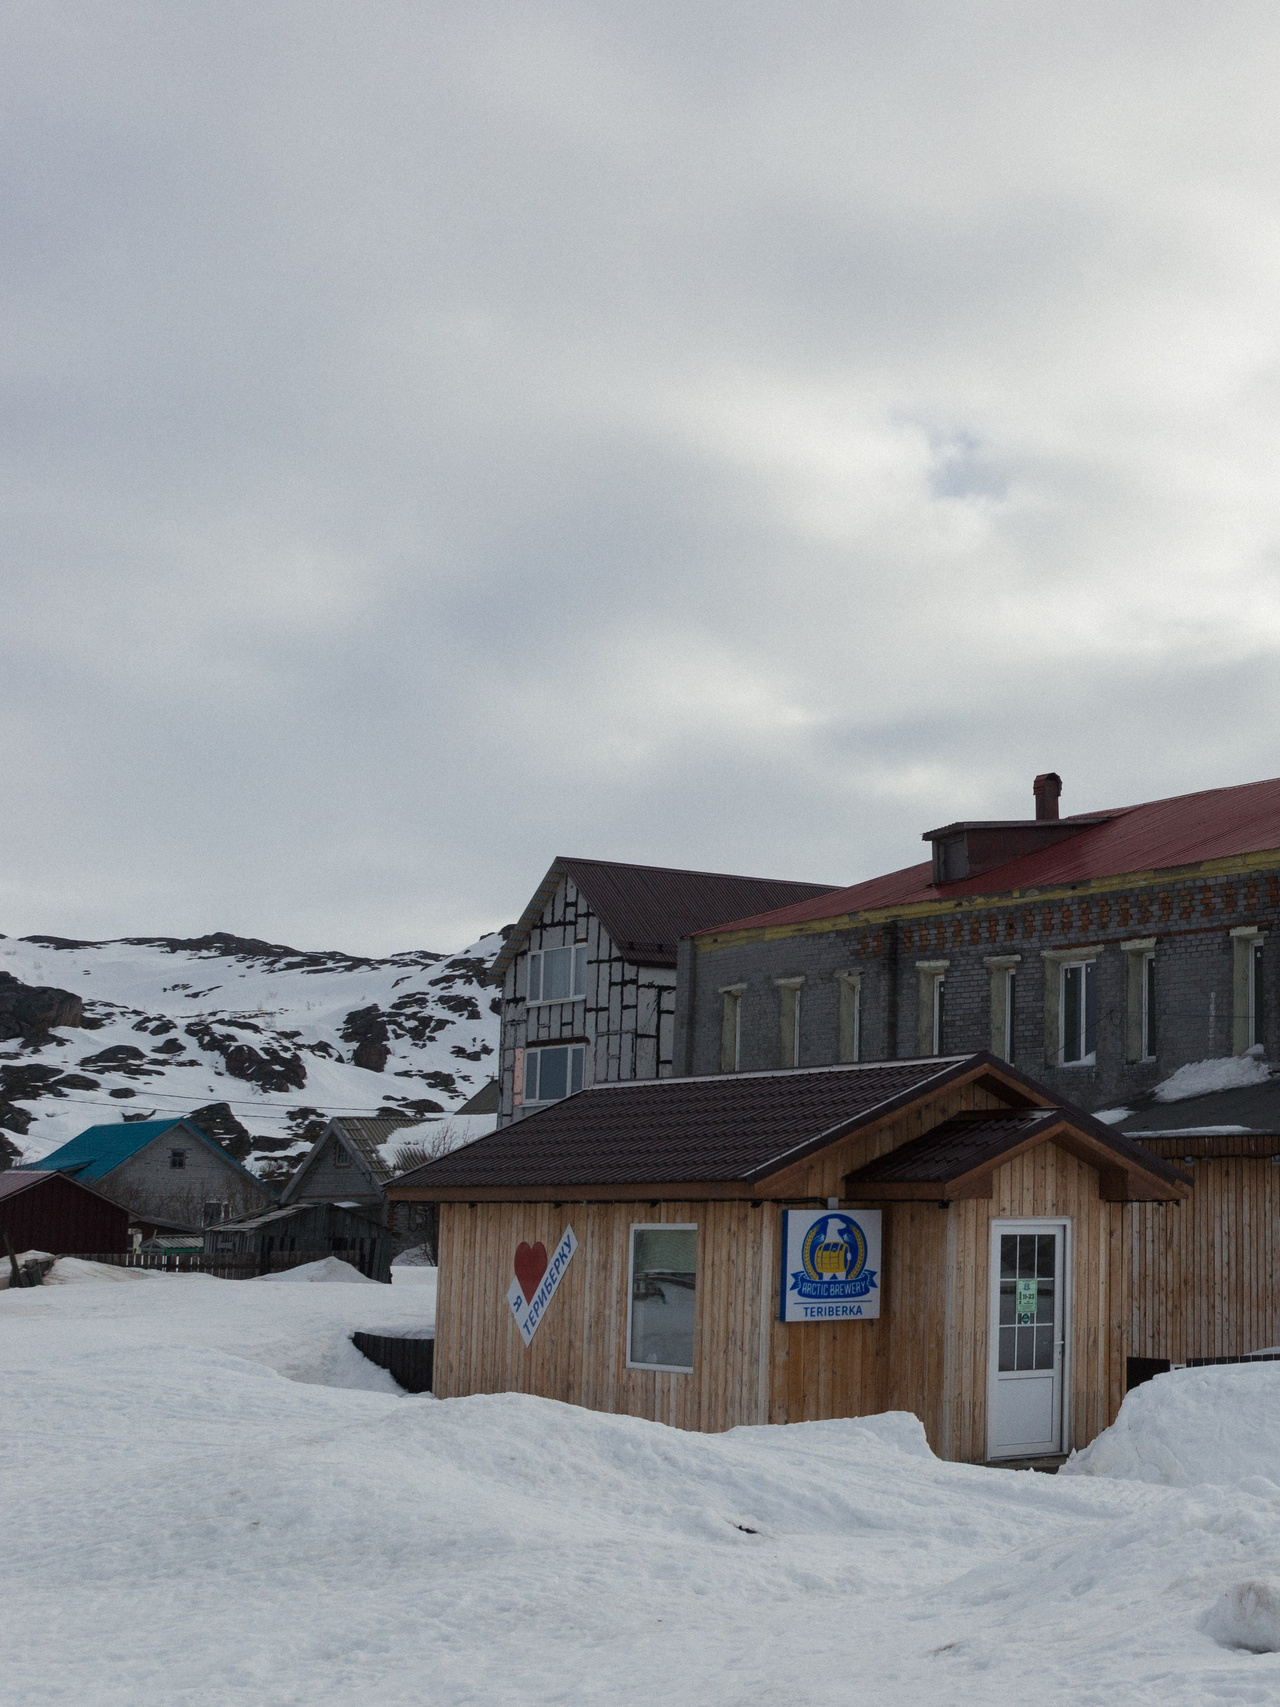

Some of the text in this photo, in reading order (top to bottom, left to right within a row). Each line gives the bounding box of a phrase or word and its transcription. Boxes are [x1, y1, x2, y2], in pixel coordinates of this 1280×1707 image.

[523, 1234, 573, 1336] ТЕРИБЕРКУ
[802, 1281, 866, 1295] ARCTIC BREWERY
[513, 1295, 523, 1312] Я
[803, 1305, 863, 1317] TERIBERKA
